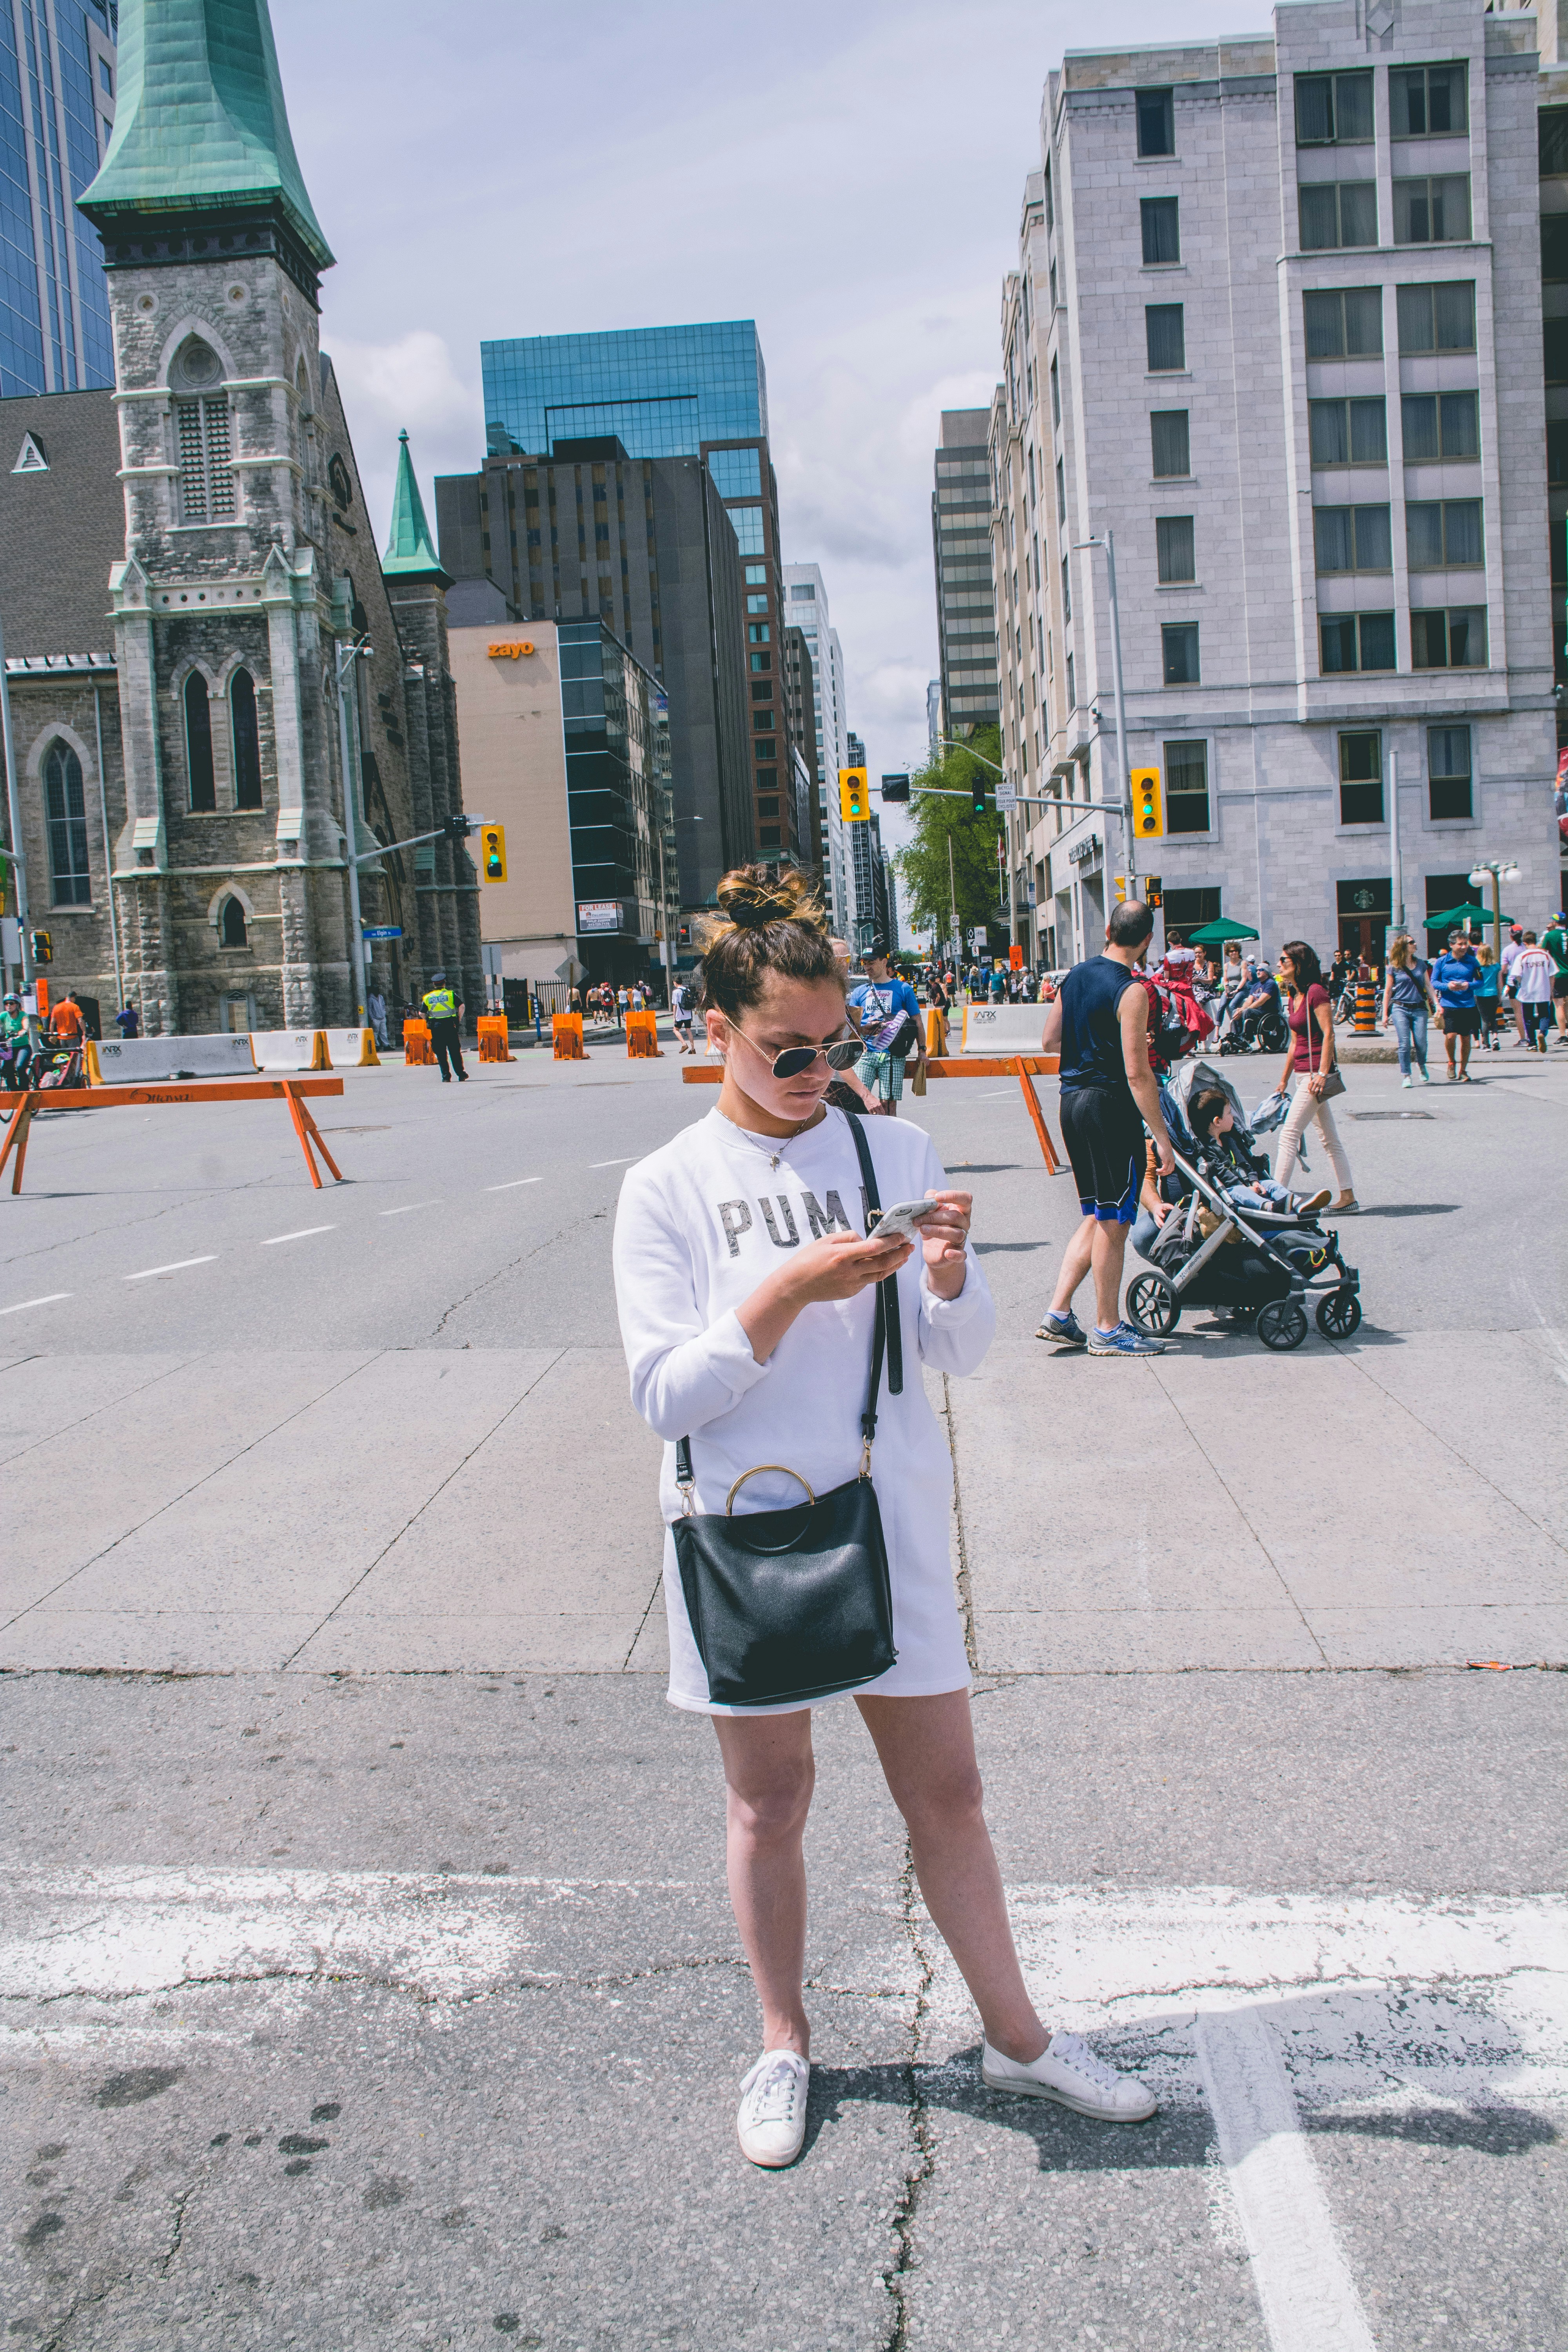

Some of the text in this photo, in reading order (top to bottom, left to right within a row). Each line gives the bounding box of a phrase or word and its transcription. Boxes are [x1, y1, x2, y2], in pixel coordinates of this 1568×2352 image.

[488, 642, 534, 659] zayo
[1154, 895, 1160, 906] 5
[717, 1186, 869, 1258] PUM
